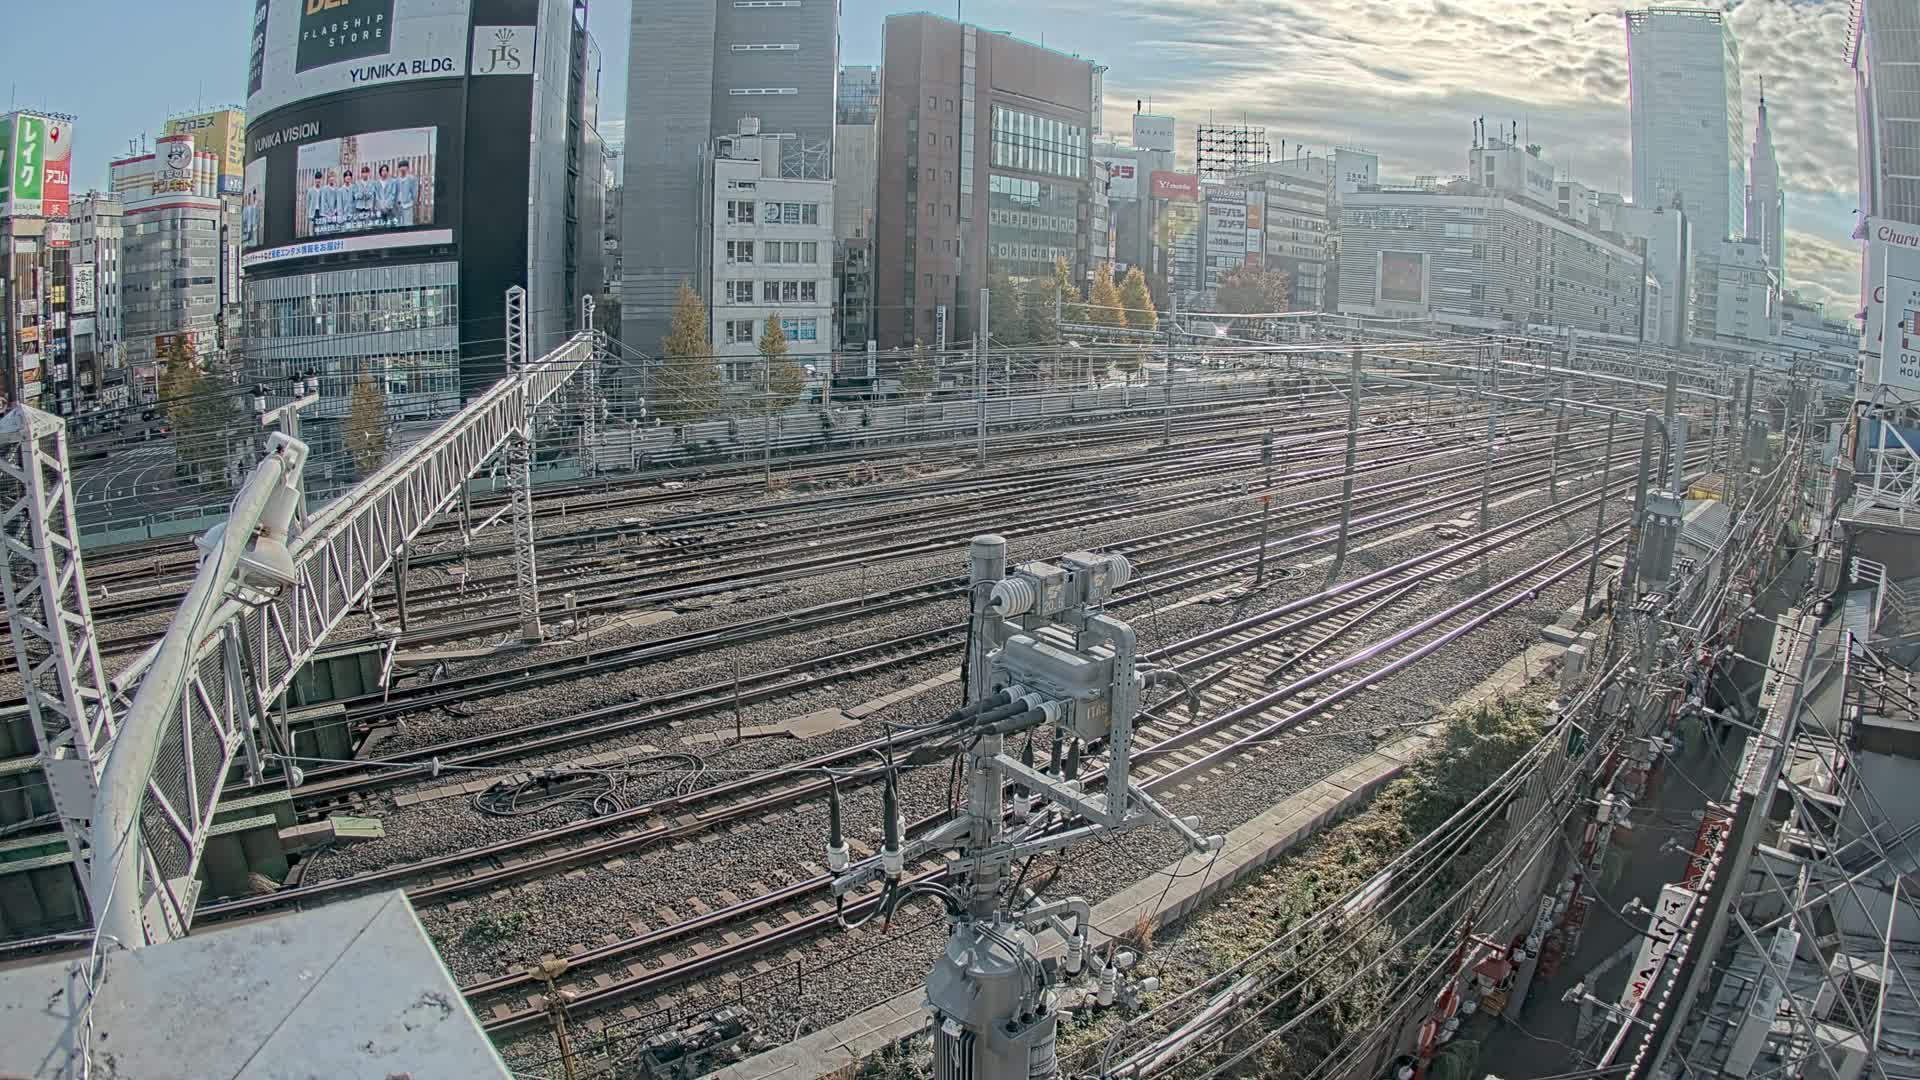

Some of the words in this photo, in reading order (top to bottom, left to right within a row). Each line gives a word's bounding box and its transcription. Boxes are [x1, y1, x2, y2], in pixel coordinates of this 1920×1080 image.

[304, 14, 383, 41] FLAGSHIP
[329, 28, 382, 47] STORE
[350, 61, 407, 83] YUNIKA
[412, 57, 456, 75] BLDG.
[254, 131, 281, 153] YUNIKA
[282, 121, 320, 143] VISION
[21, 120, 38, 188] レイク
[45, 168, 69, 185] アコム
[1877, 225, 1919, 248] Churu
[1900, 353, 1920, 367] OP
